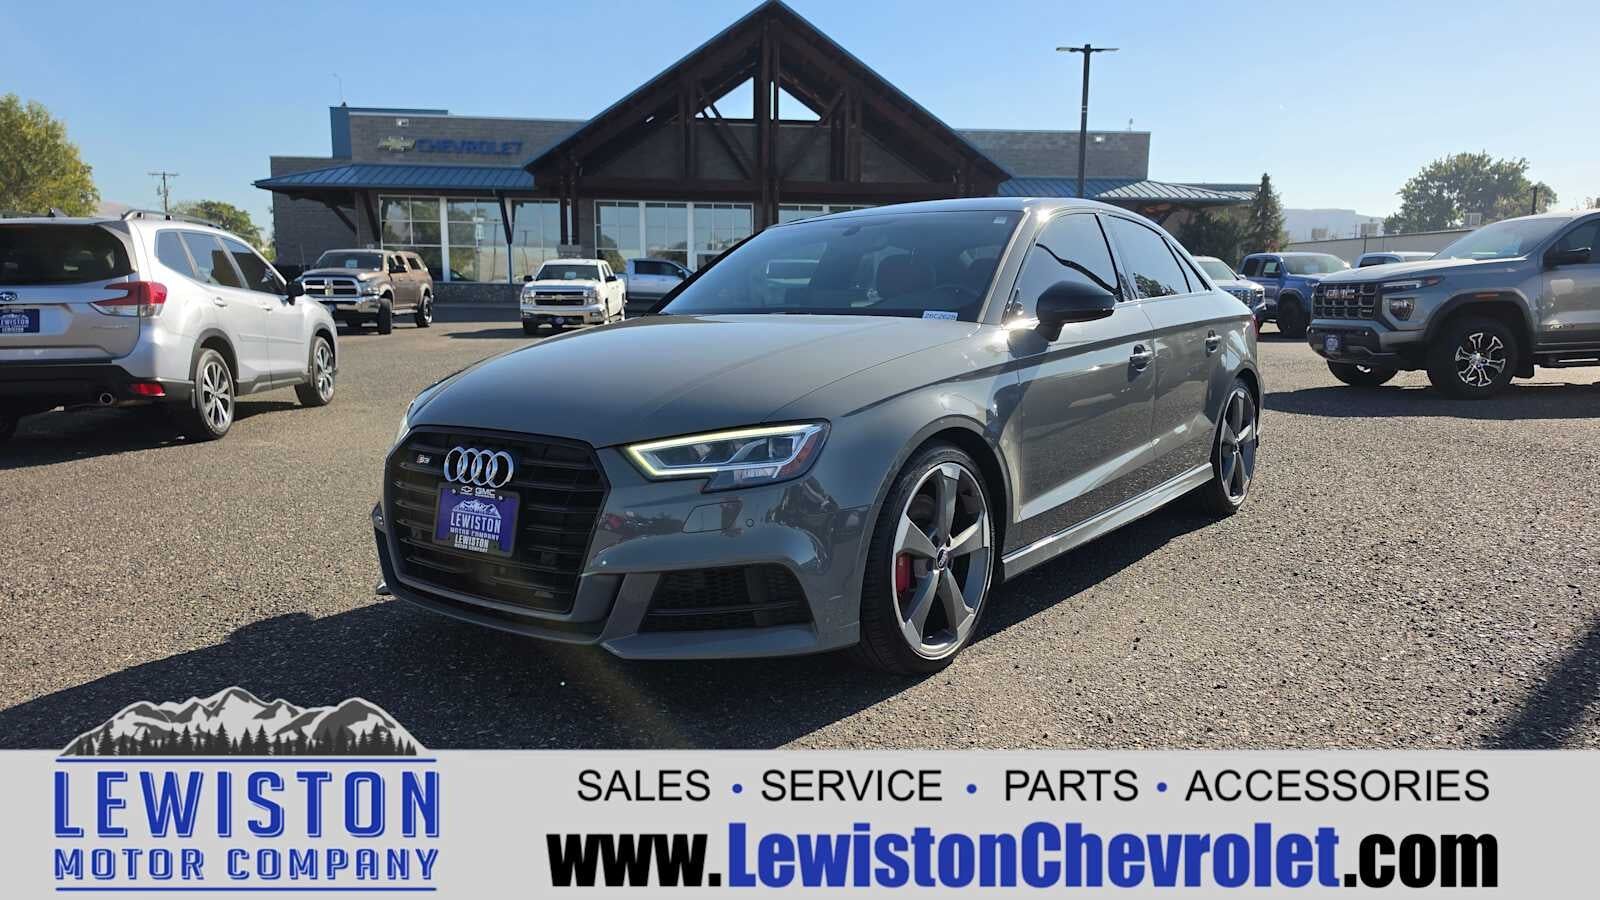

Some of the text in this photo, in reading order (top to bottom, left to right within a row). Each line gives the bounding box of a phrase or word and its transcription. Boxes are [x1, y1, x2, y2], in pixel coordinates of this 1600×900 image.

[416, 139, 523, 156] CHEVROLET
[475, 487, 496, 496] GMC
[450, 512, 502, 534] LEWISTON
[454, 534, 490, 549] LEWISTON
